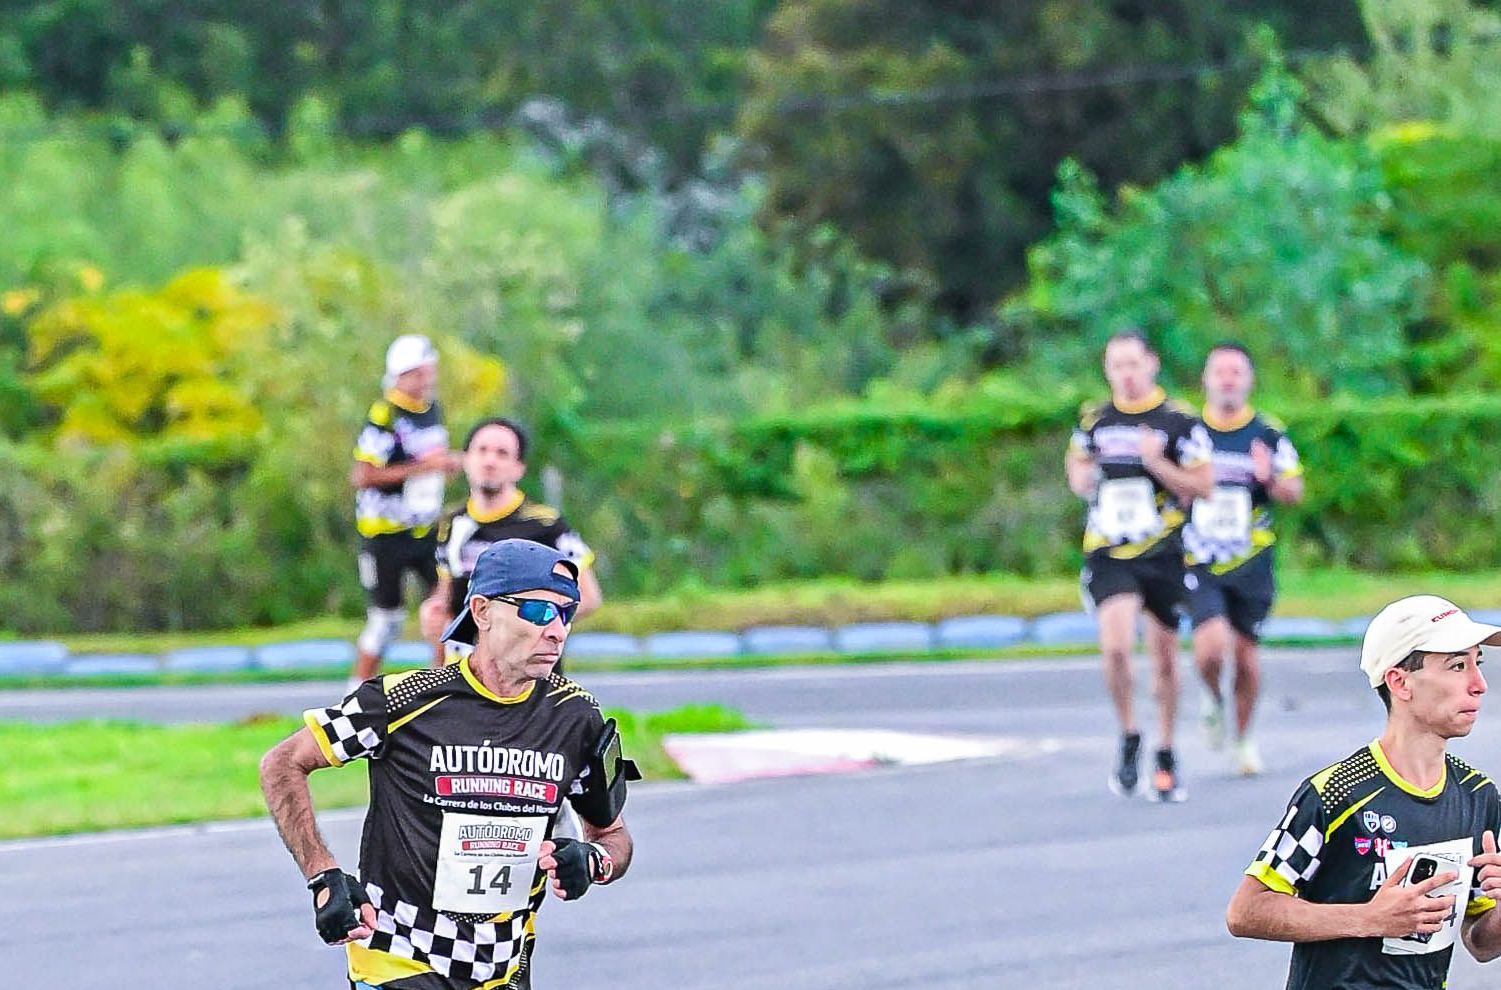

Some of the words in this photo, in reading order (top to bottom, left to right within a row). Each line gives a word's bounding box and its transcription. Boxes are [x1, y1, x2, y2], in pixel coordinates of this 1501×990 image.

[429, 739, 565, 781] AUTÓDROMO
[450, 777, 511, 794] RUNNING
[513, 780, 547, 800] RACE
[423, 793, 434, 804] La
[434, 796, 467, 809] Carrera
[467, 800, 479, 809] de
[479, 800, 492, 811] los
[493, 801, 521, 812] Clubes
[522, 804, 536, 813] del
[458, 821, 533, 842] AUTÓDROMO
[469, 840, 501, 850] RUNNING
[501, 841, 520, 851] RACE
[466, 864, 513, 895] 14
